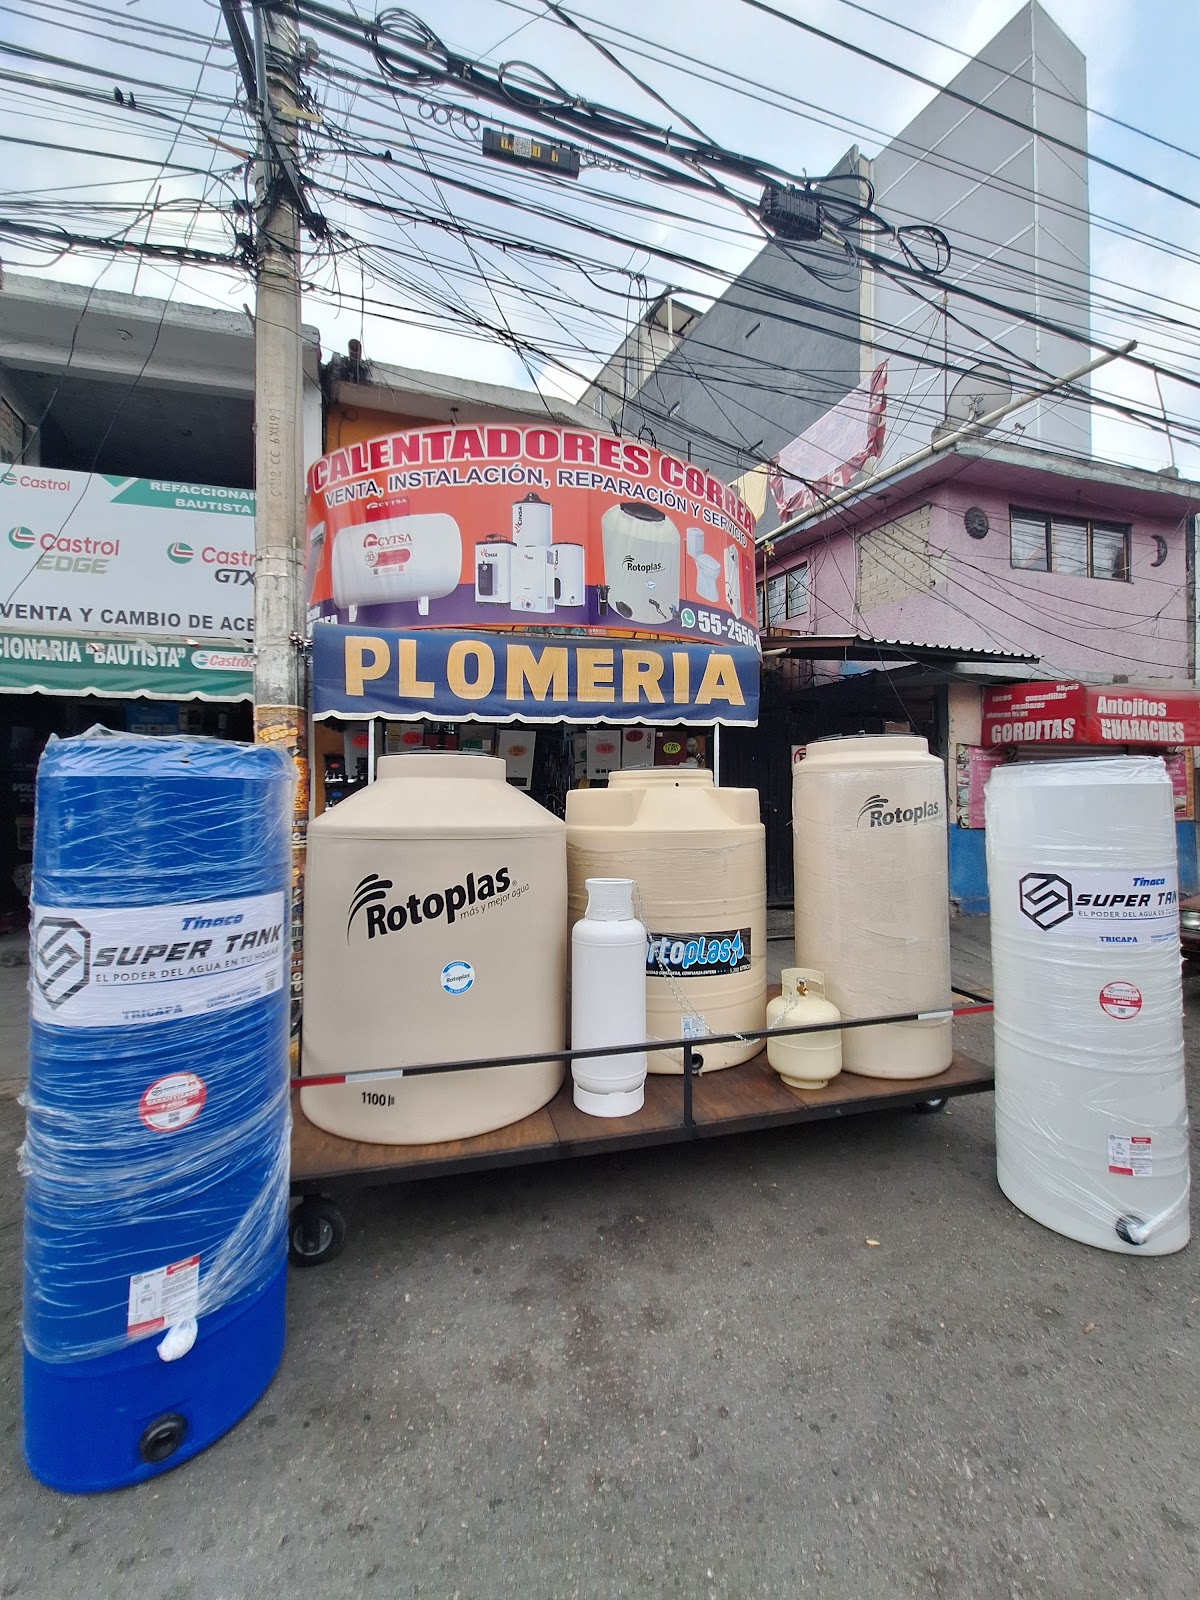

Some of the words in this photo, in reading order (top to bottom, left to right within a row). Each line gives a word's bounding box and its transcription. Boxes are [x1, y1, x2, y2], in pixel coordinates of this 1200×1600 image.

[20, 475, 70, 491] Castrol
[313, 427, 651, 493] CALENTADORES
[659, 454, 754, 537] CORREA
[175, 498, 252, 514] BAUTISTA
[325, 481, 383, 508] VENTA,
[388, 463, 550, 491] INSTALACIÓN,
[557, 469, 688, 514] REPARACIÓN
[691, 501, 703, 518] Y
[702, 507, 748, 548] SERVICIO
[40, 533, 120, 556] Castrol
[377, 533, 413, 546] CYTSA
[36, 555, 110, 575] EDGE
[201, 546, 256, 567] Castr
[214, 569, 256, 586] GTX
[627, 562, 662, 574] Rotoplas
[0, 603, 72, 623] VENTA
[79, 608, 94, 623] Y
[100, 608, 181, 628] CAMBIO
[189, 614, 214, 630] DE
[345, 635, 746, 706] PLOMERIA
[1097, 695, 1167, 718] Antojitos
[991, 717, 1076, 744] GORDITAS
[869, 801, 939, 828] Rotoplas
[1133, 877, 1165, 887] Tinaco
[366, 867, 511, 939] Rotoplas
[460, 906, 480, 920] más
[481, 902, 487, 914] y
[487, 892, 510, 910] mejor
[512, 883, 530, 899] agua
[1075, 893, 1151, 907] SUPER
[181, 914, 244, 931] Tinaco
[1091, 910, 1120, 918] PODER
[1138, 910, 1157, 918] AGUA
[92, 939, 213, 967] SUPER
[225, 923, 282, 954] TANK
[96, 973, 109, 982] EL
[114, 971, 156, 982] PODER
[161, 967, 184, 978] DEL
[190, 962, 221, 975] AGUA
[224, 959, 239, 969] EN
[240, 956, 252, 965] TU
[446, 973, 470, 983] Rotoplas
[362, 1091, 386, 1106] 1100
